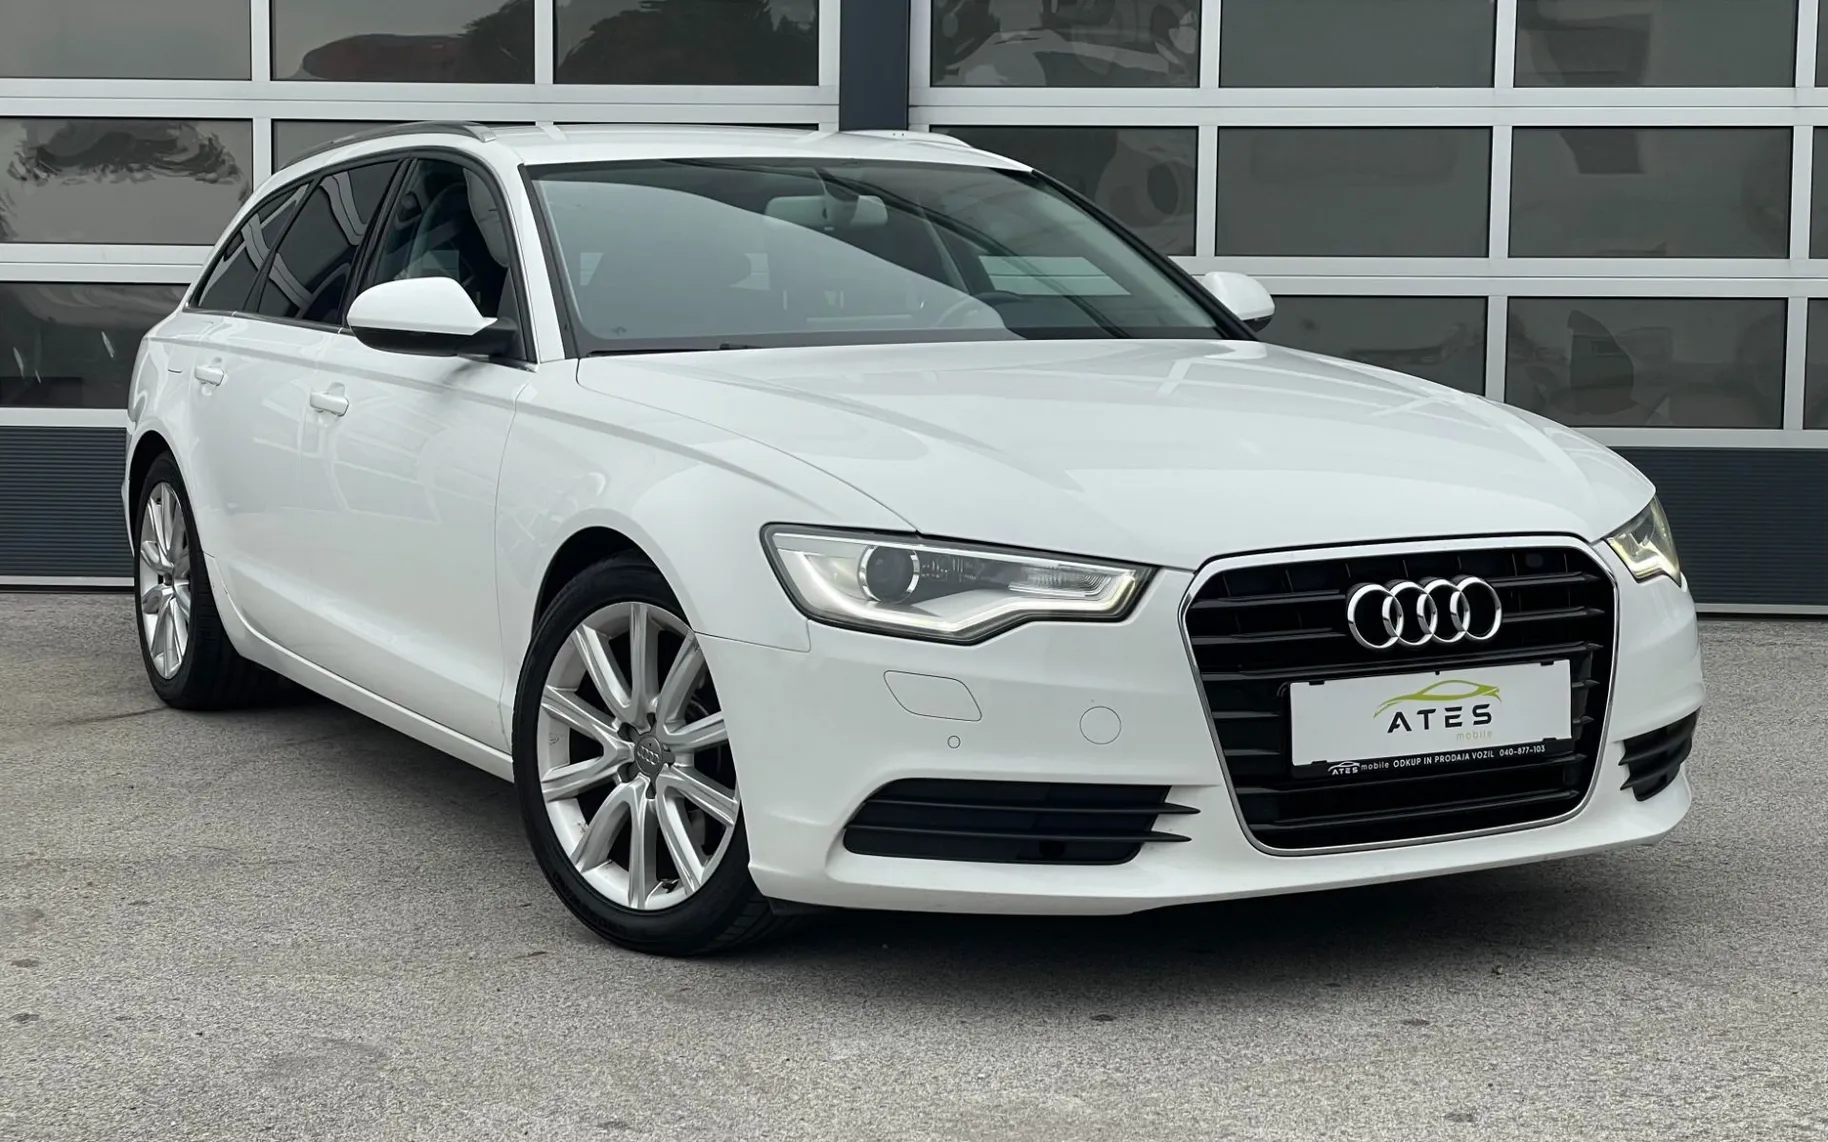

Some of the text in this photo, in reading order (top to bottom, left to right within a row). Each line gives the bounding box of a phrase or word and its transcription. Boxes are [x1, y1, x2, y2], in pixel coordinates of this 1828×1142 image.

[1387, 704, 1492, 733] ATES
[1456, 730, 1493, 741] mobile
[1332, 745, 1546, 775] ATES mobile ODKUP IN PRODAJA VOZIL 040-877-103
